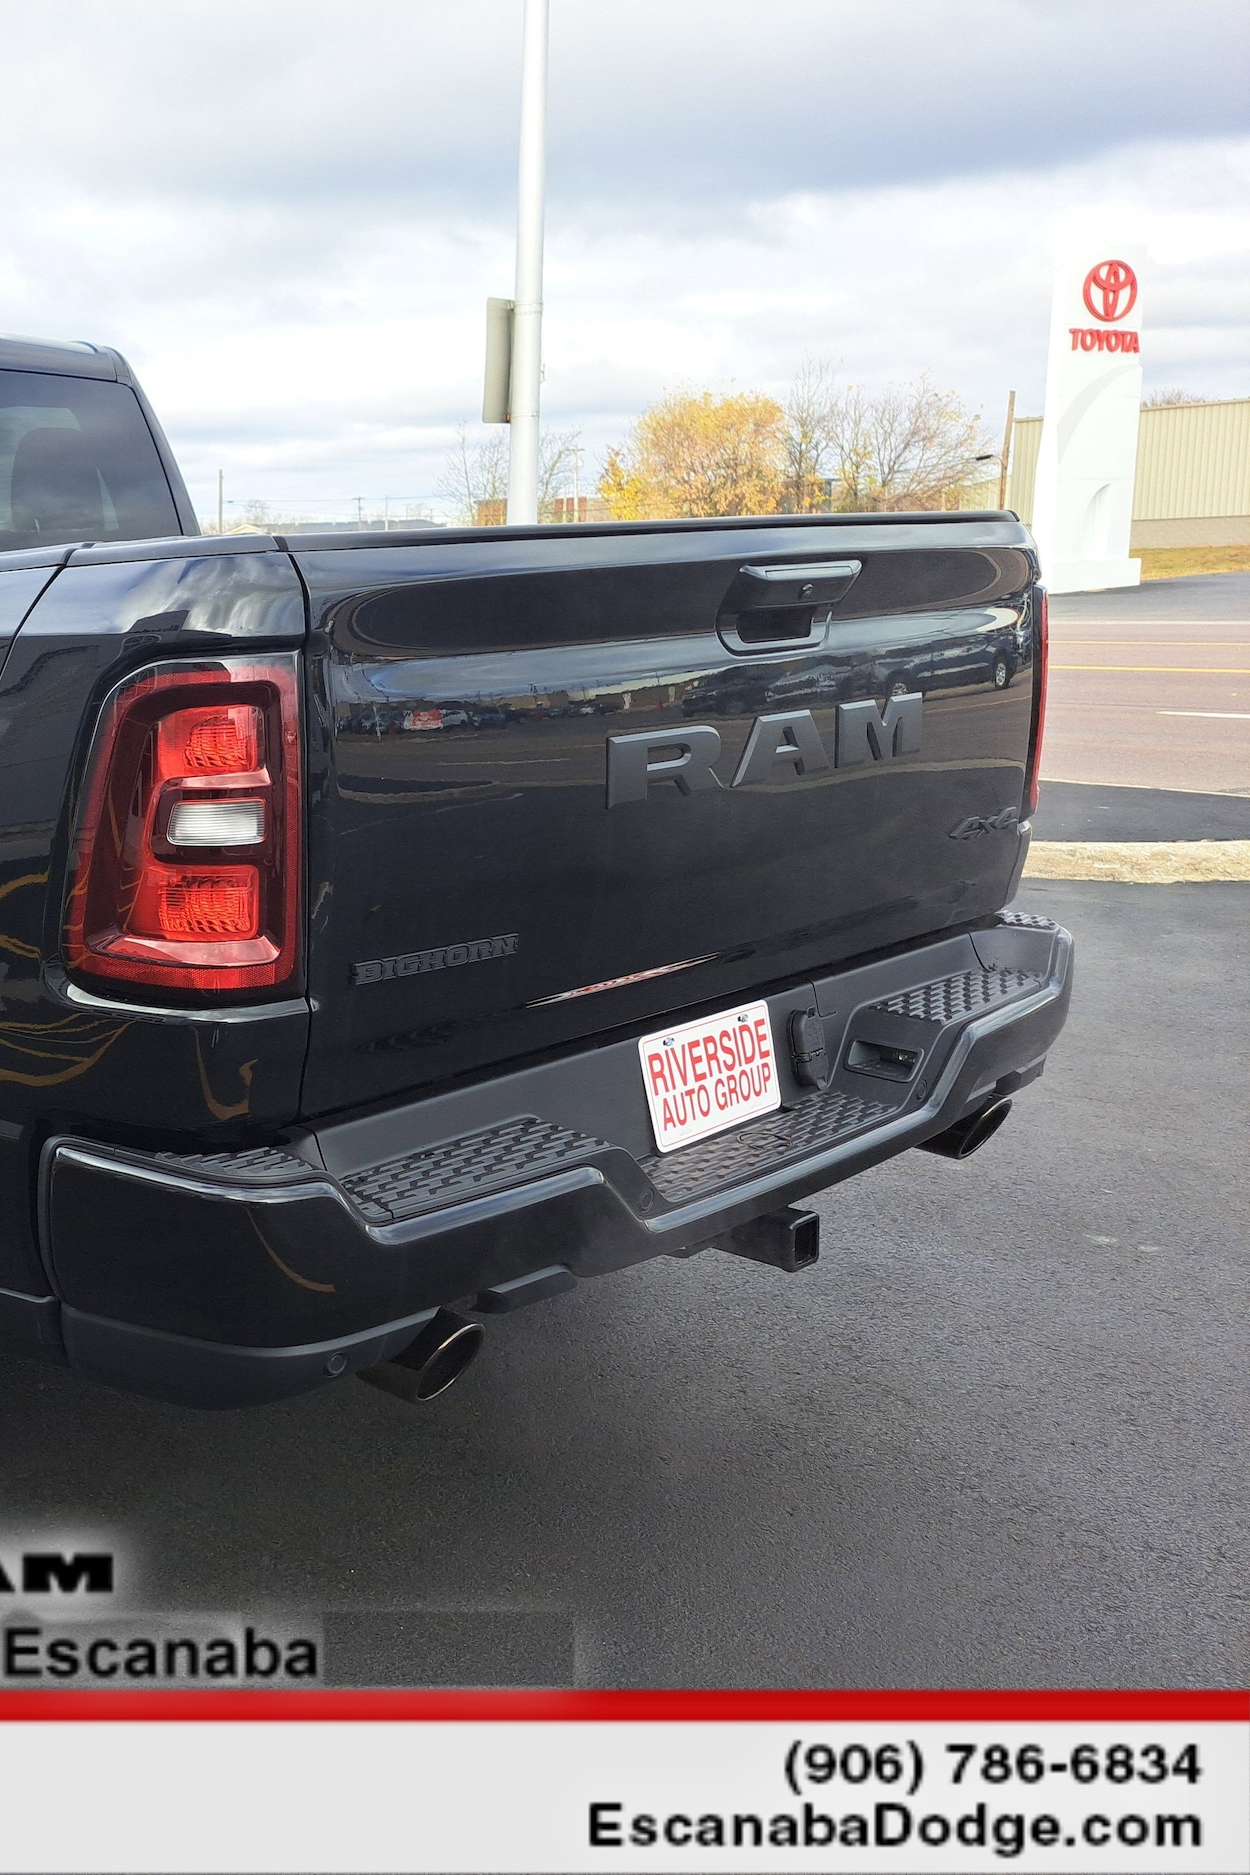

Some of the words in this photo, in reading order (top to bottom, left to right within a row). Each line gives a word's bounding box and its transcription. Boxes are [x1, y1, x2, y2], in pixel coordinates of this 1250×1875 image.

[1069, 328, 1140, 354] TOYOTA
[605, 692, 923, 810] RAM
[351, 933, 519, 985] BIGHORN
[647, 1018, 771, 1097] RIVERSIDE
[663, 1084, 711, 1131] AUTO
[714, 1062, 771, 1111] GROUP
